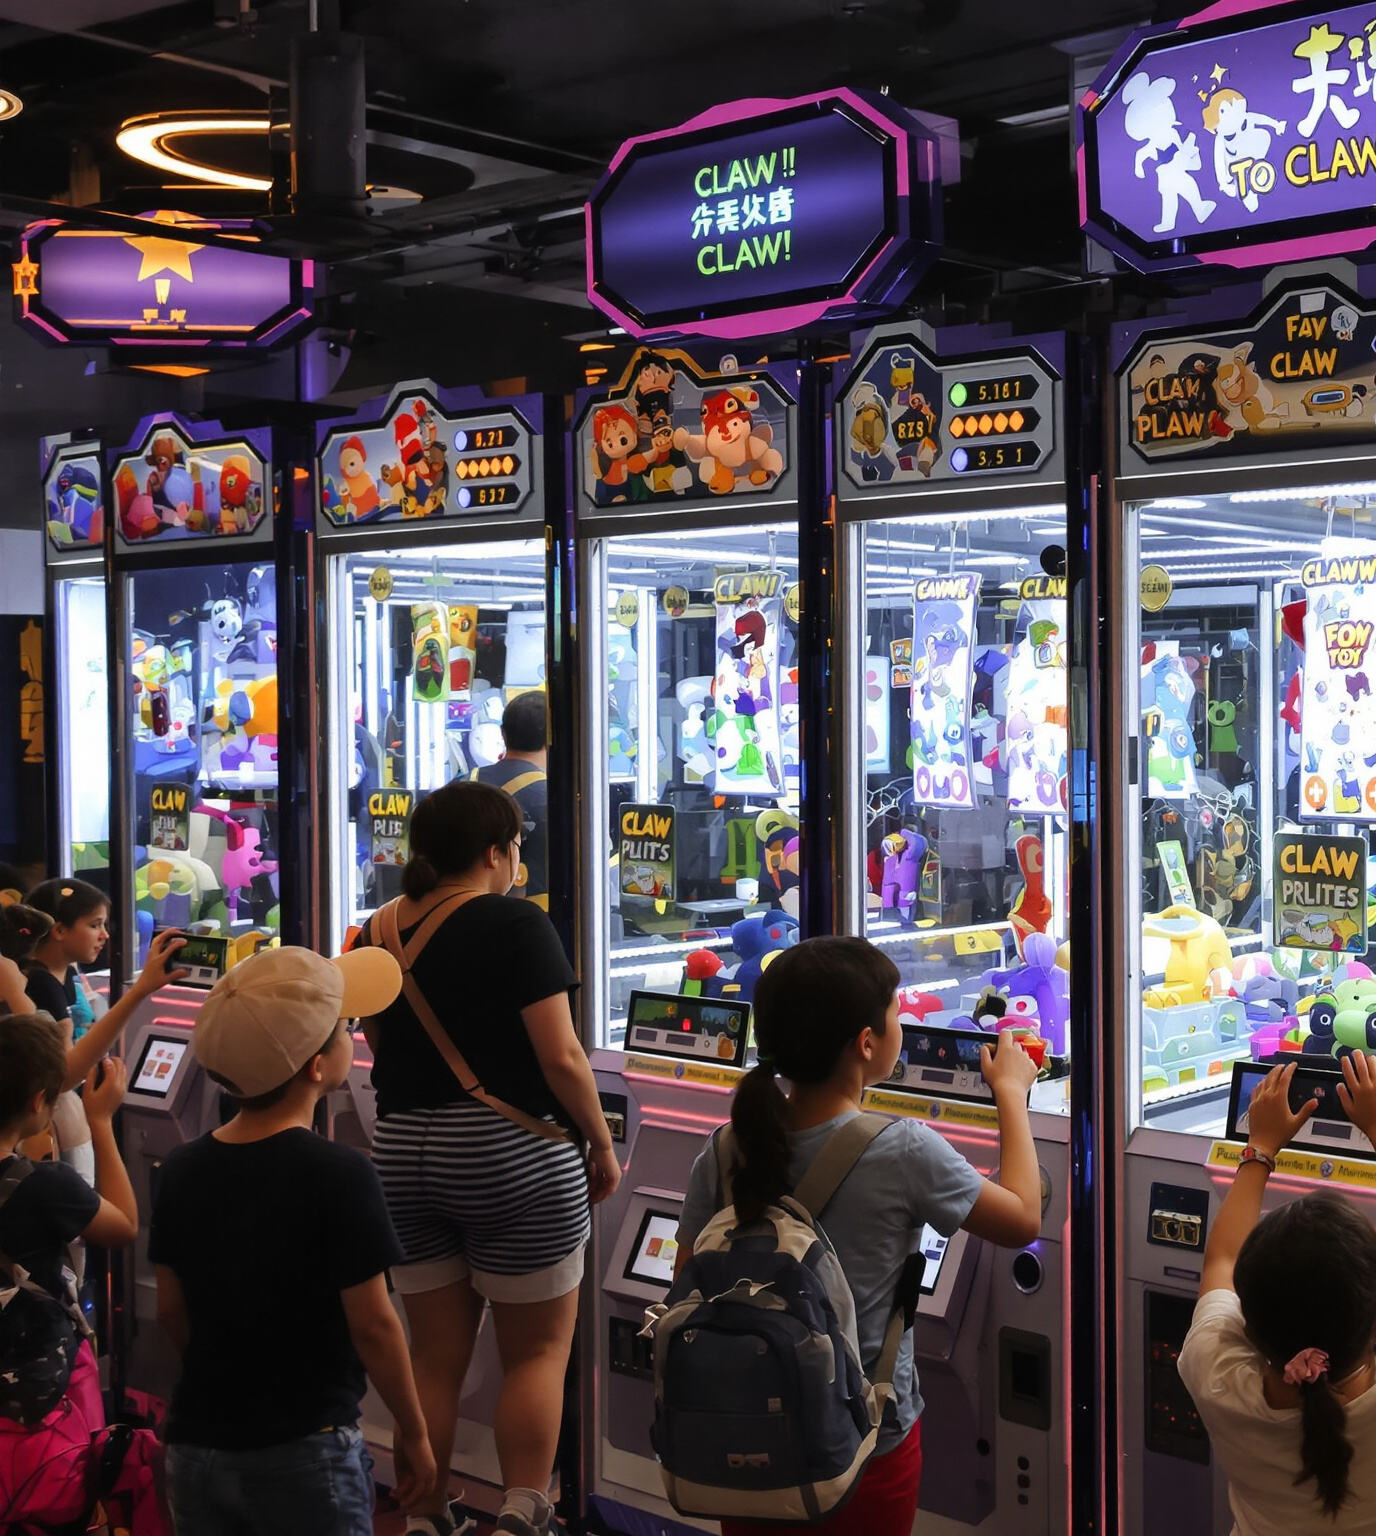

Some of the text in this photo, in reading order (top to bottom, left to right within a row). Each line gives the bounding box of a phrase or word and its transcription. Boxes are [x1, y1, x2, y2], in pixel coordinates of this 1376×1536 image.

[1229, 158, 1276, 197] TO
[697, 229, 791, 275] CLAW!
[1270, 347, 1338, 379] CLAW
[1136, 410, 1205, 442] PLAW
[152, 788, 186, 812] CLAW
[368, 793, 410, 817] CLAW
[622, 811, 672, 839] CLAW
[1280, 844, 1359, 880] CLAW
[1282, 879, 1359, 908] PRLITES
